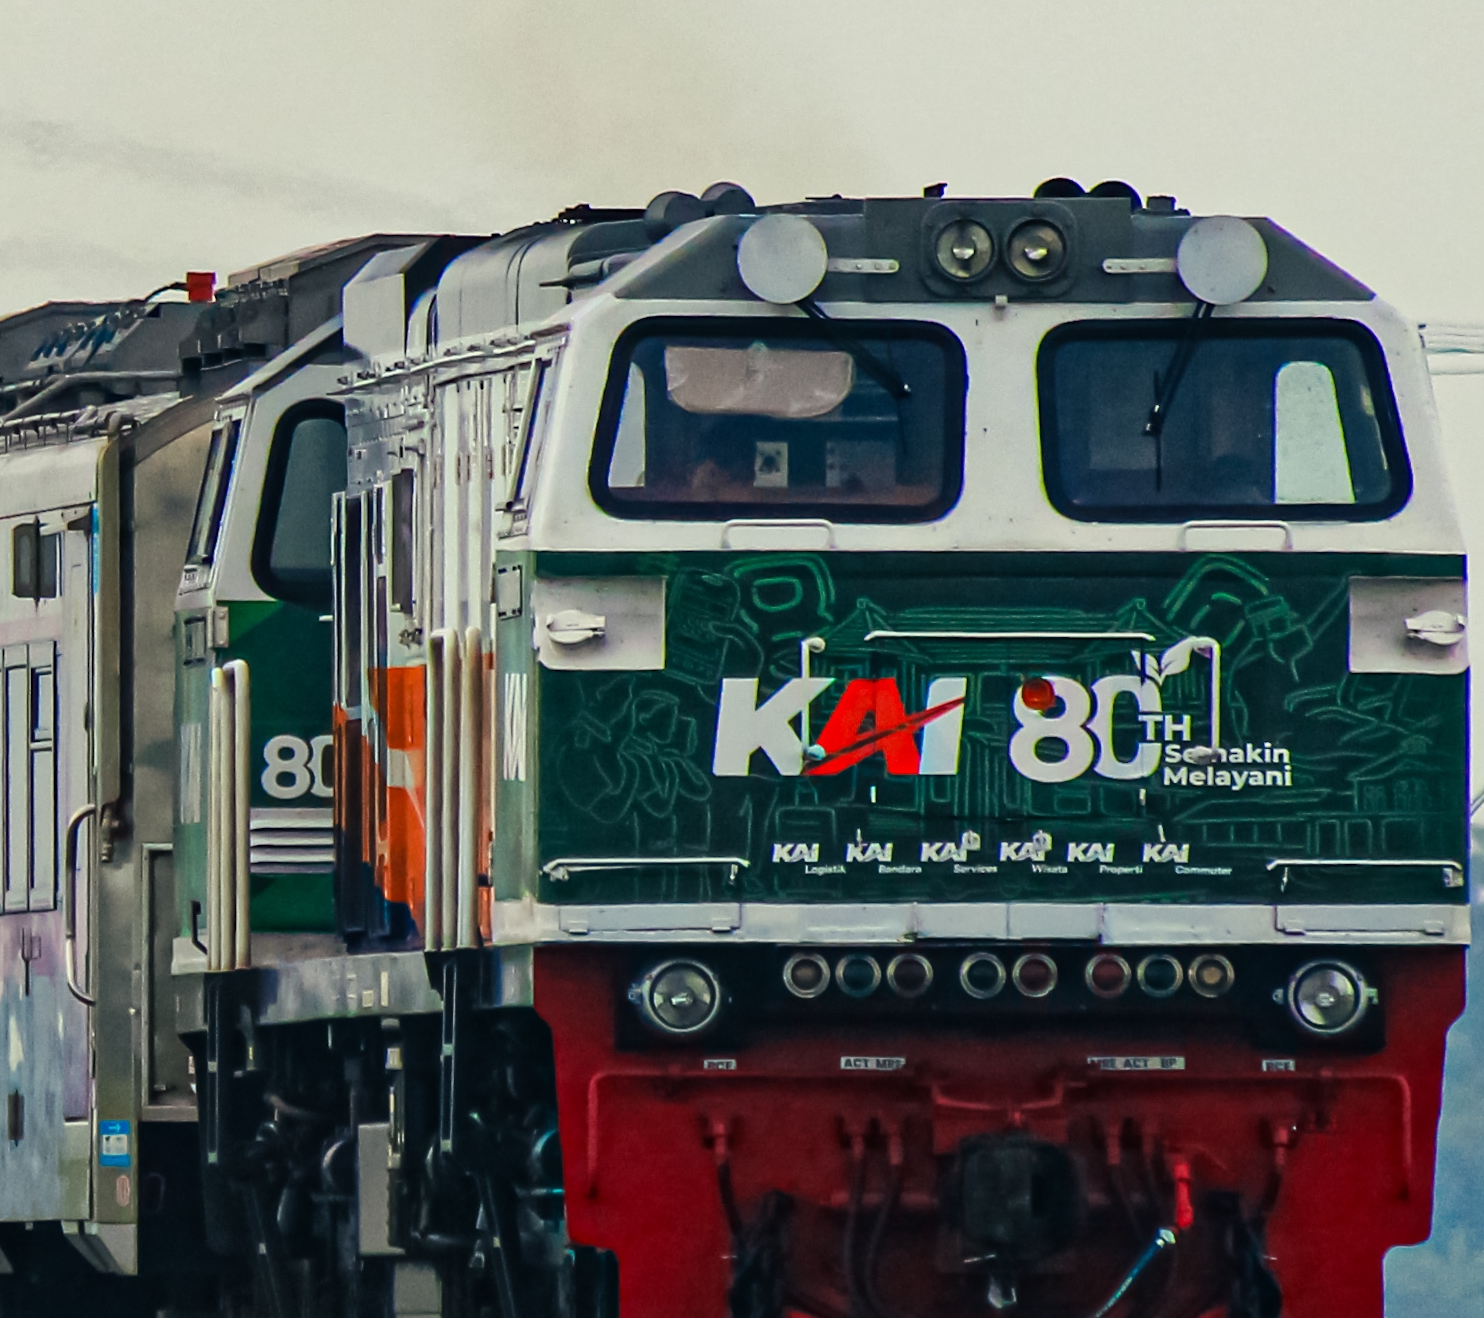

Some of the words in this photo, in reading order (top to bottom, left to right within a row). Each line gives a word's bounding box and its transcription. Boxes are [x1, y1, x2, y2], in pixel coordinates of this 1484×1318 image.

[713, 677, 967, 776] KAI
[1009, 675, 1163, 783] 80
[1139, 714, 1192, 742] TH
[1163, 765, 1293, 791] Melayani
[772, 843, 820, 863] KAI
[846, 843, 894, 863] KAI
[1067, 843, 1115, 863] KAI
[1143, 843, 1190, 863] KAI
[804, 864, 846, 876] Logistik
[953, 864, 998, 874] Services
[1099, 864, 1143, 875] Properti
[1175, 865, 1232, 876] Commuter
[844, 1058, 870, 1068] ACT
[1123, 1058, 1149, 1068] ACT
